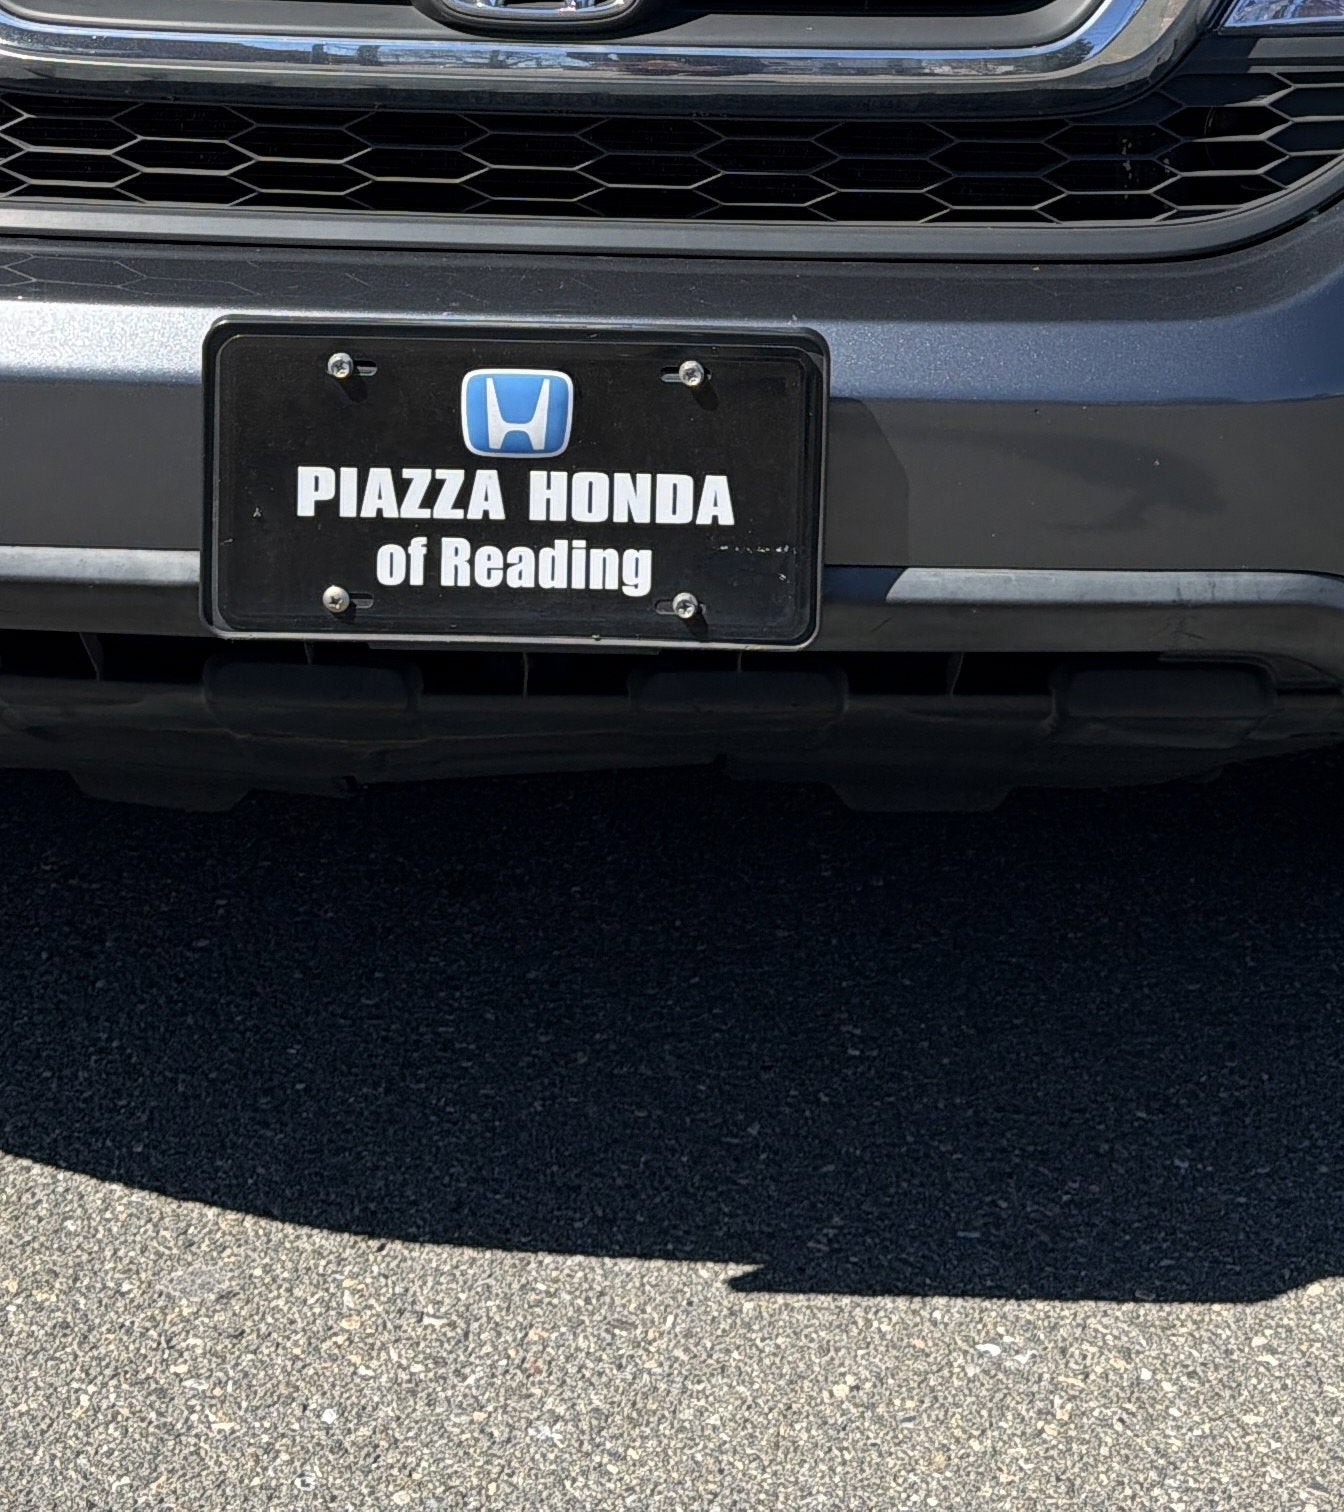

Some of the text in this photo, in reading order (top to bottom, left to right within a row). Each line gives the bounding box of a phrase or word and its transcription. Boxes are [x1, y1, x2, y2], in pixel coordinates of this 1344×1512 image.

[296, 466, 735, 526] PIAZZA HONDA
[376, 536, 653, 597] of Reading
